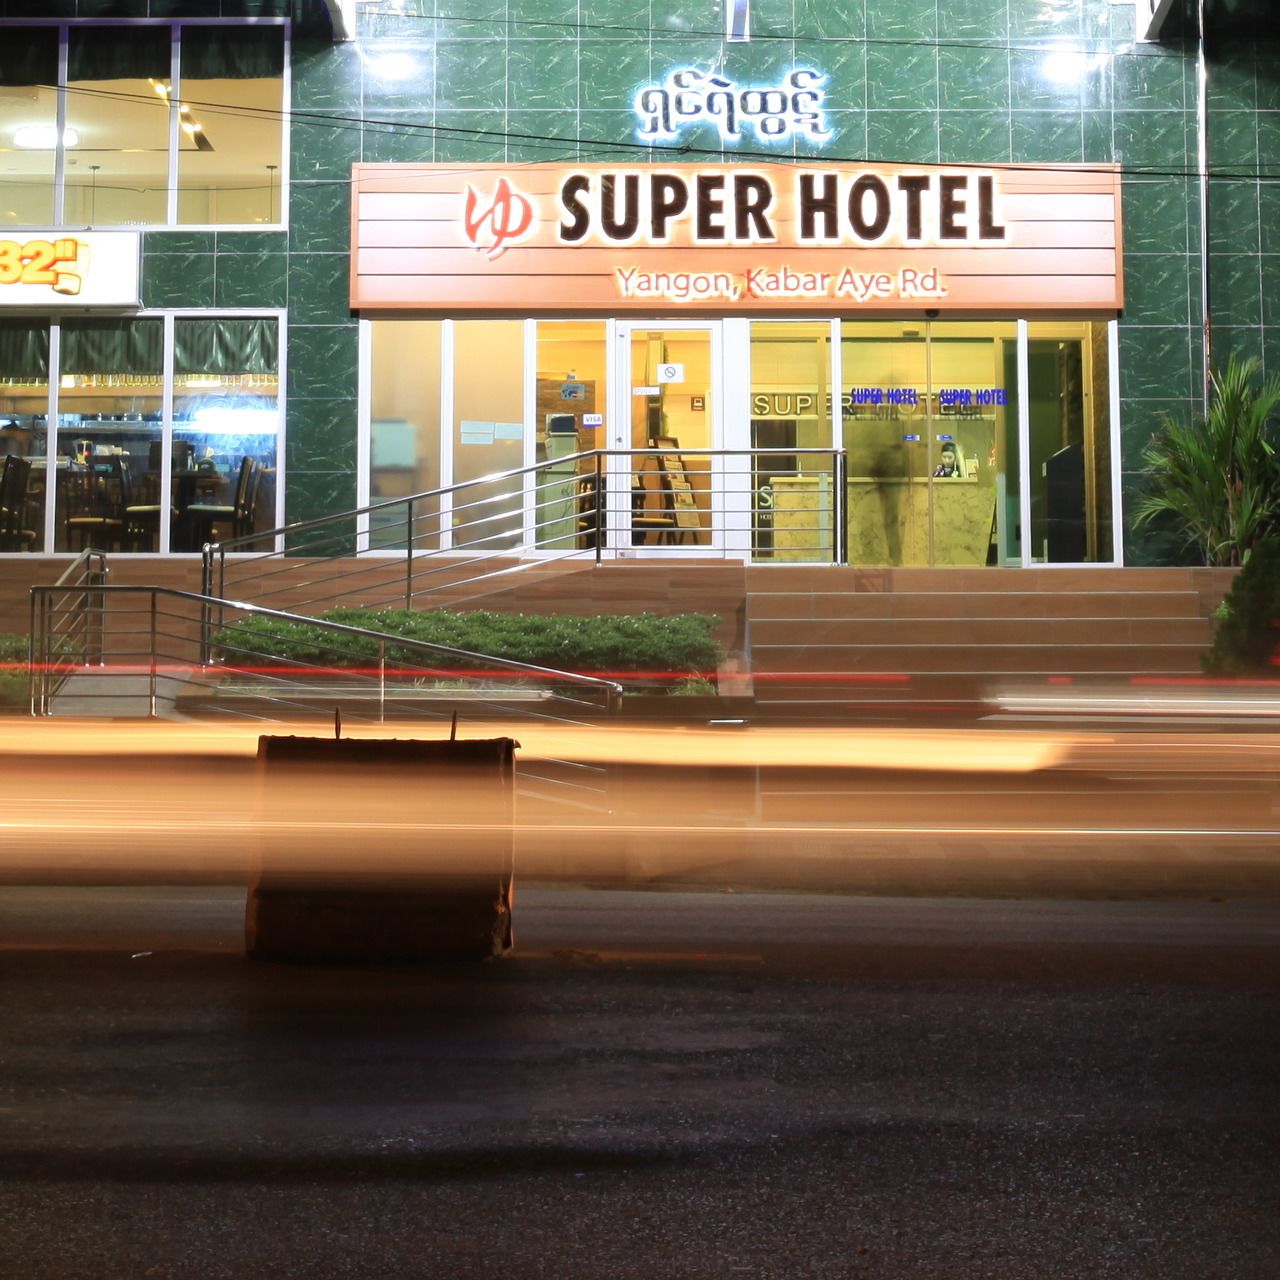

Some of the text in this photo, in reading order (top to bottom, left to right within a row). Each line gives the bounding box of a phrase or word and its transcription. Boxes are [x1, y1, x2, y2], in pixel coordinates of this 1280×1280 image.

[560, 173, 1006, 241] SUPER HOTEL
[618, 267, 947, 300] Yangon, Kabar Aye Rd.
[851, 388, 919, 405] SUPER HOTEL
[939, 388, 1008, 405] SUPER HOTEL
